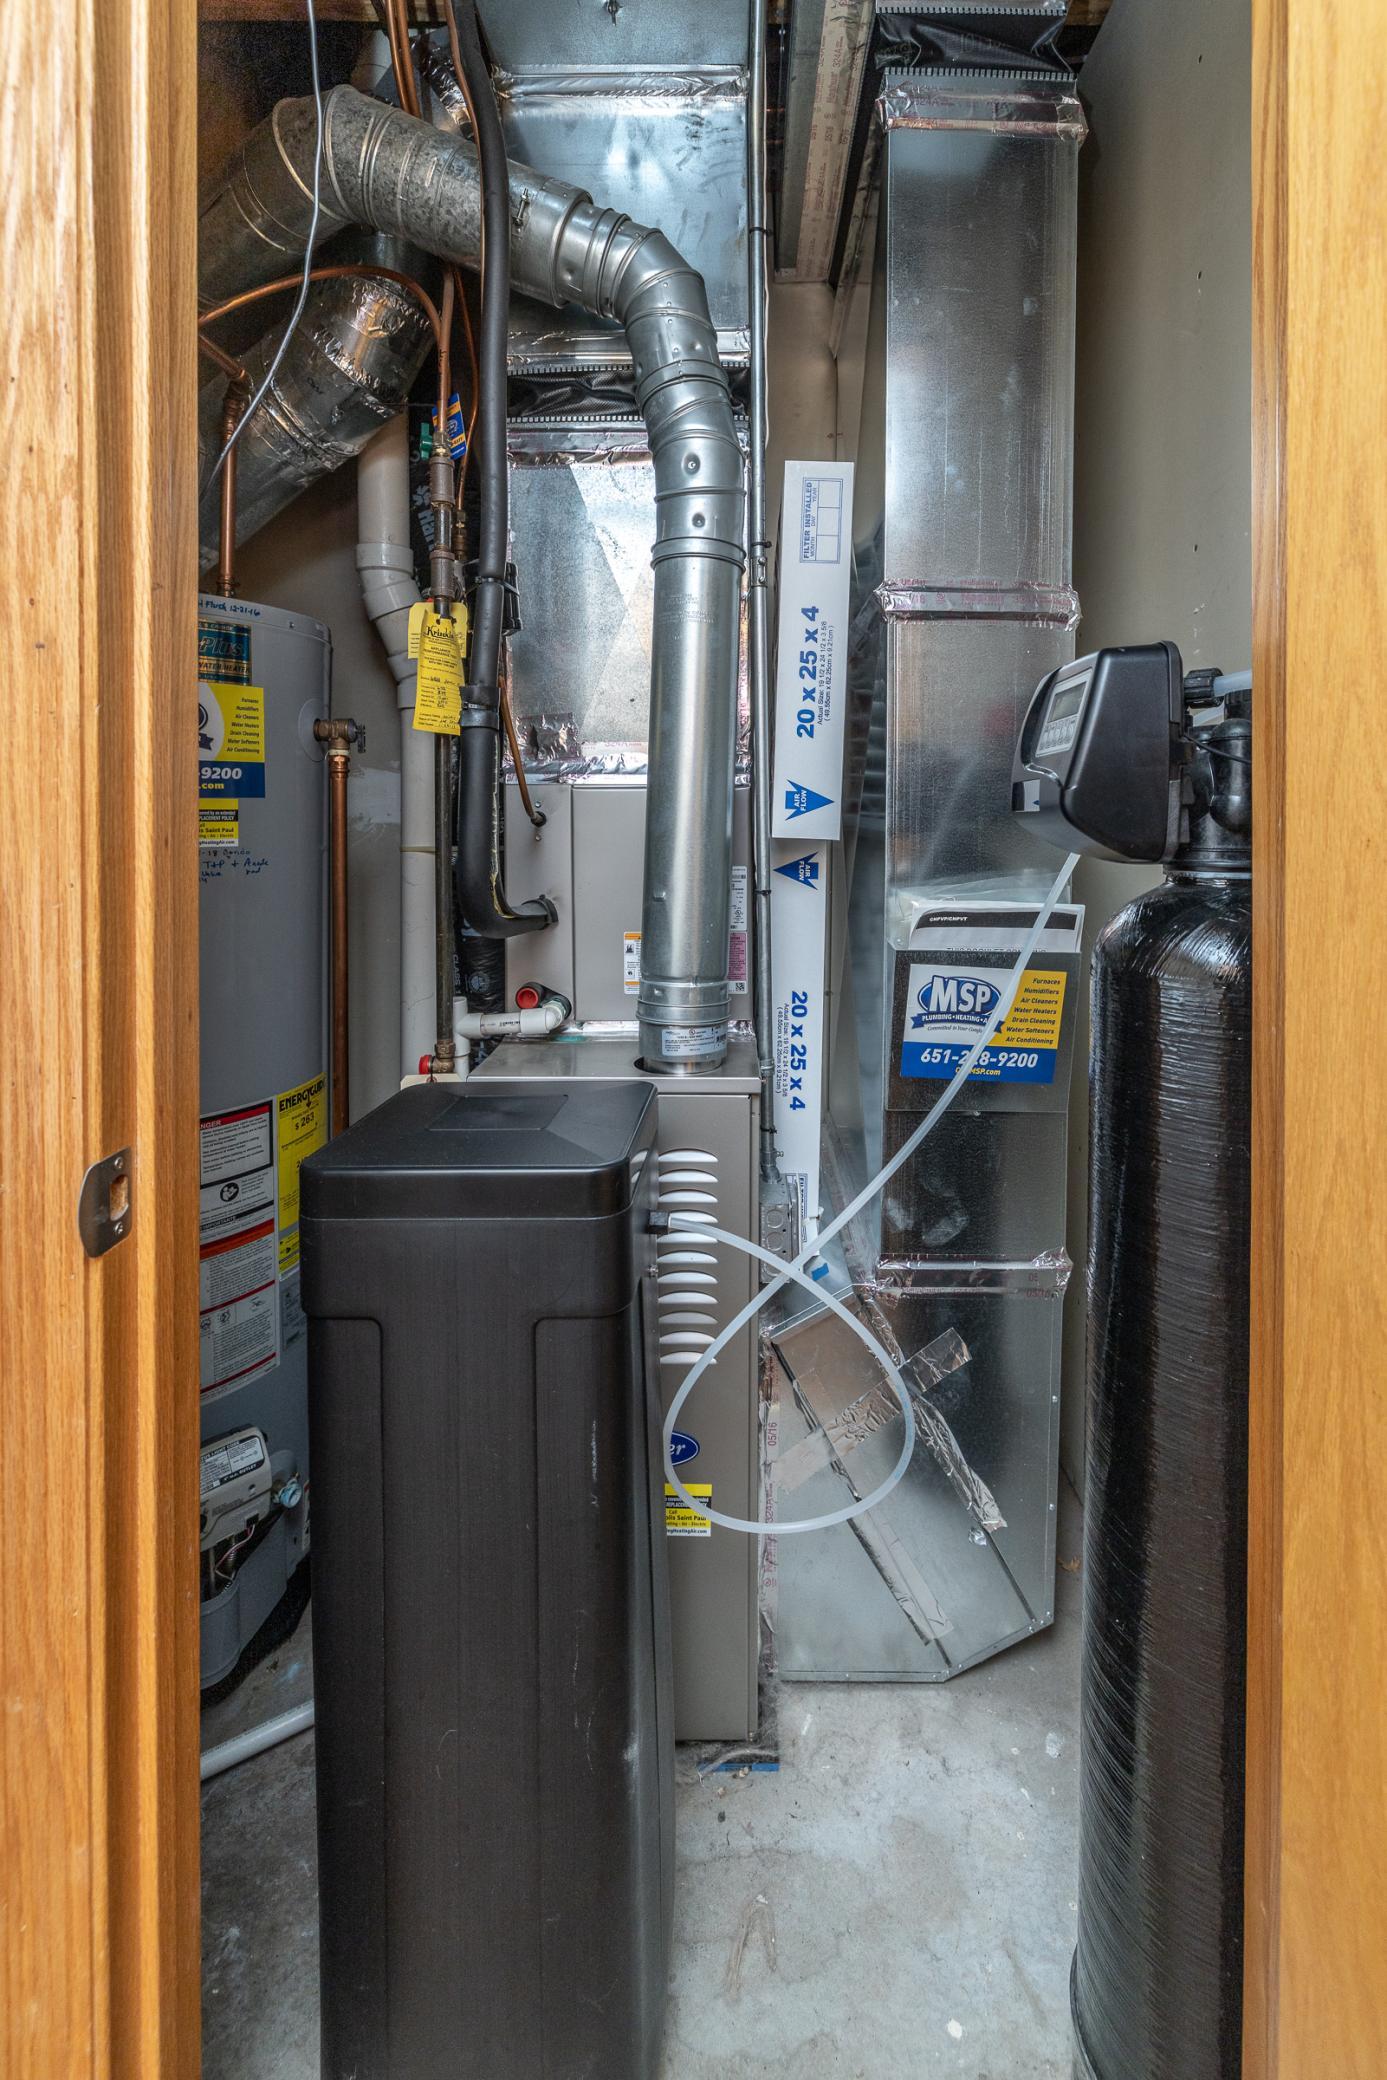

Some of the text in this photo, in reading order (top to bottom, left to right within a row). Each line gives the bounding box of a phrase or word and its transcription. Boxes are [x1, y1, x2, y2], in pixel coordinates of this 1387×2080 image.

[803, 482, 812, 559] FILTER INSTALLED
[820, 654, 826, 662] 24
[796, 606, 819, 739] 20 x 25 x 4
[819, 680, 825, 688] 19
[793, 793, 801, 807] AIR
[800, 790, 808, 812] FLOW
[929, 976, 991, 1012] MSP
[1024, 987, 1060, 995] Humidifiers
[1031, 997, 1058, 1005] Cleaners
[1029, 1017, 1056, 1025] Cleaning
[1016, 1036, 1054, 1044] Conditioning
[790, 991, 809, 1111] 20 x 25 x 4
[920, 1048, 1039, 1068] 651-28-9200
[768, 1422, 777, 1447] 05/16
